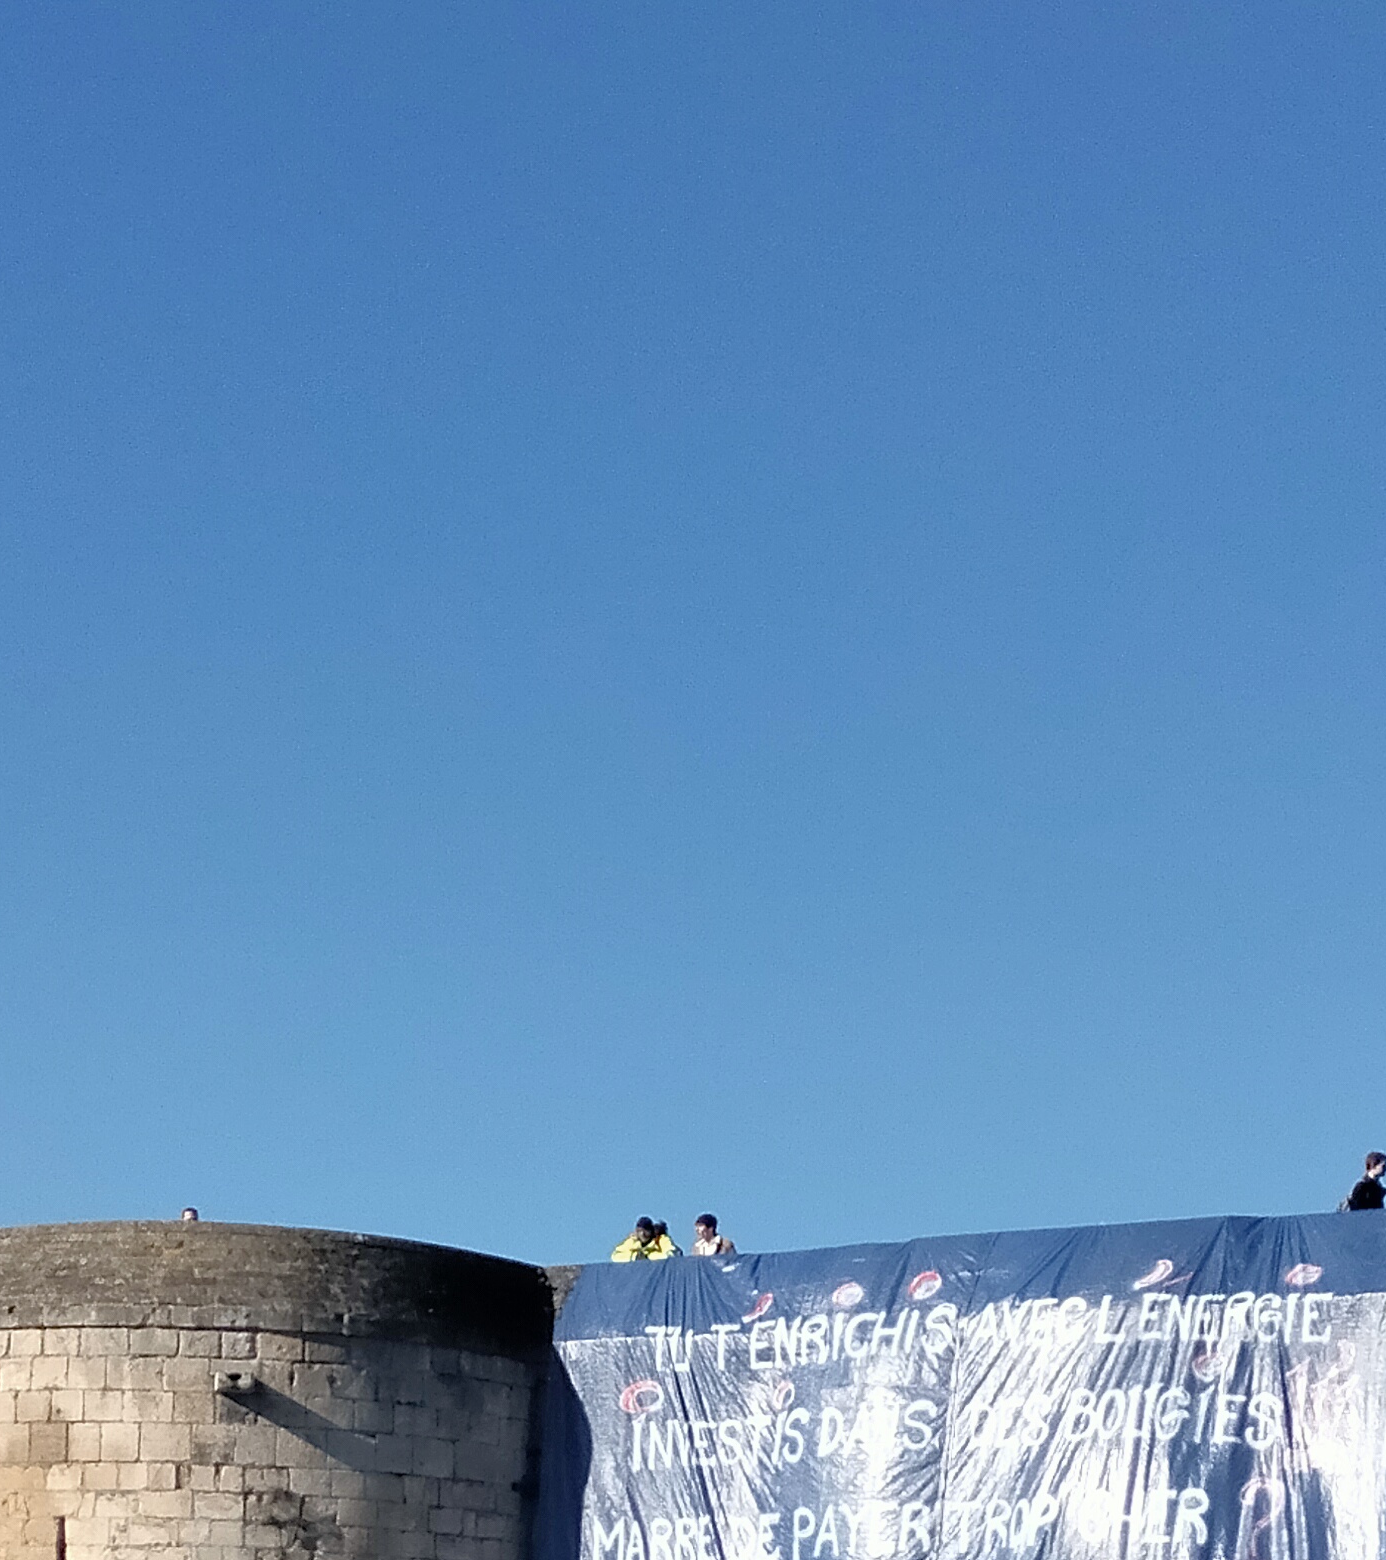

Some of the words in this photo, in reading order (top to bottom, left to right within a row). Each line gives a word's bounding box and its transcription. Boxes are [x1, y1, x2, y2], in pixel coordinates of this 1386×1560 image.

[645, 1324, 694, 1373] TU
[968, 1295, 1087, 1350] AVEC
[620, 1380, 811, 1472] INVESTIS
[971, 1389, 1050, 1448] DES
[1065, 1352, 1282, 1450] BOUGIES
[953, 1493, 1060, 1553] TROP
